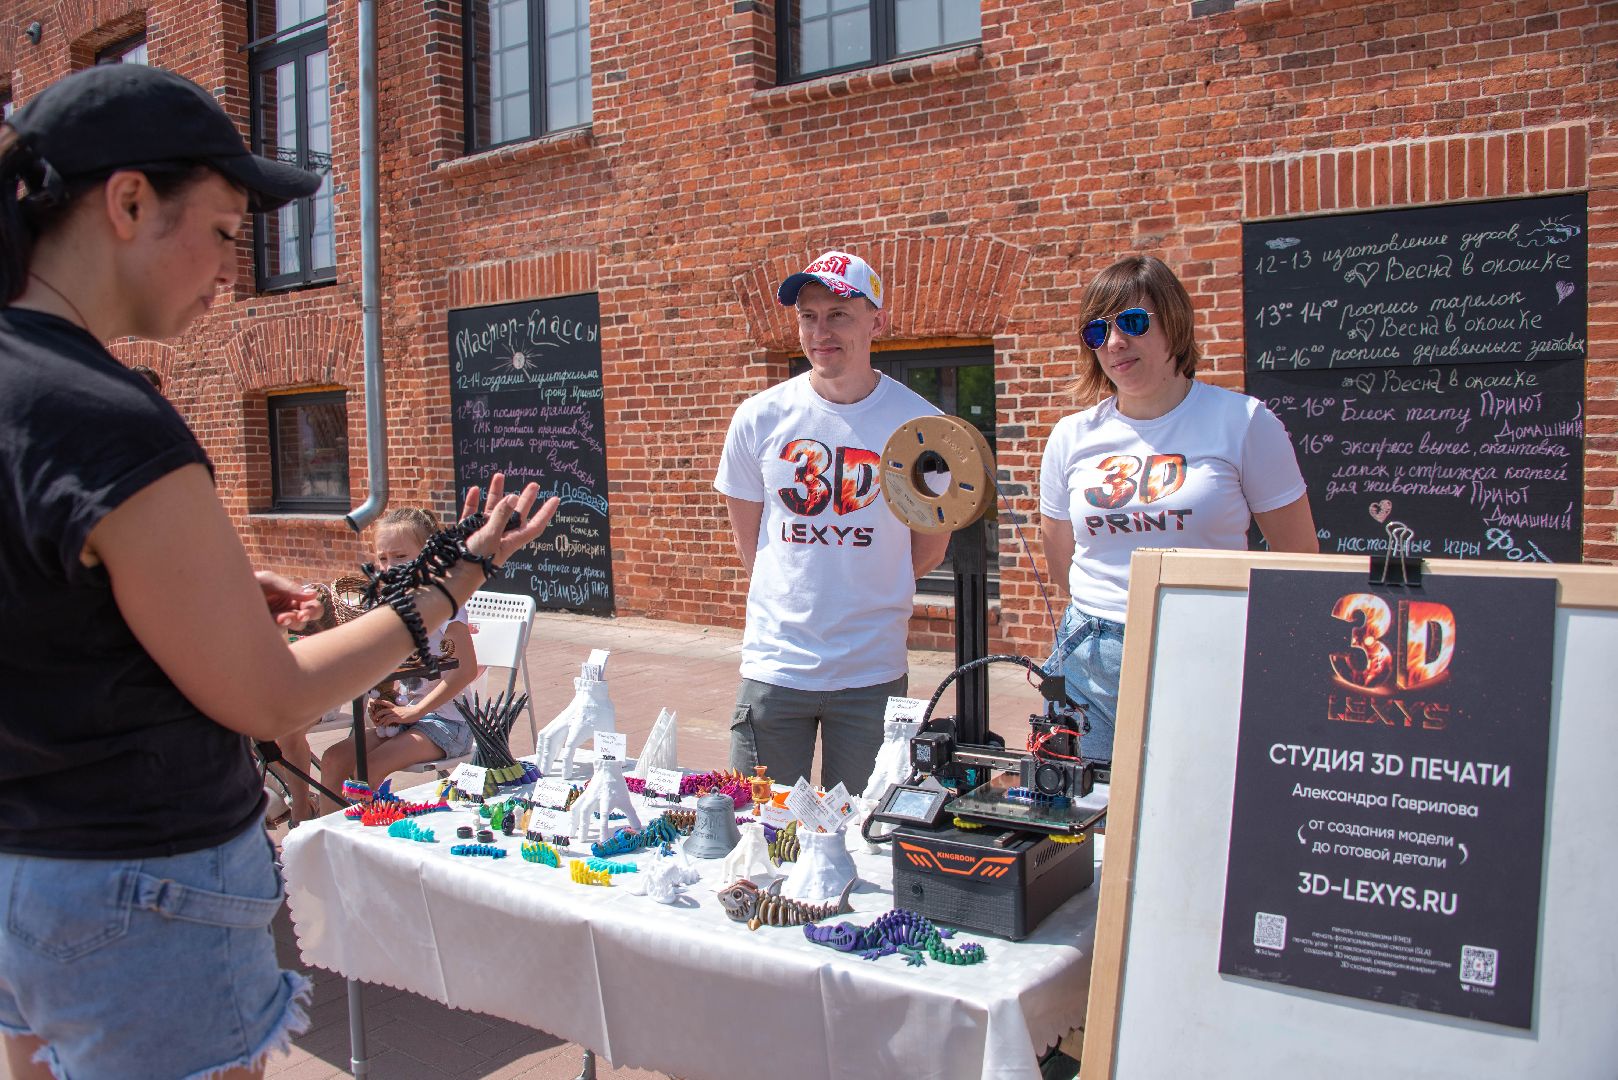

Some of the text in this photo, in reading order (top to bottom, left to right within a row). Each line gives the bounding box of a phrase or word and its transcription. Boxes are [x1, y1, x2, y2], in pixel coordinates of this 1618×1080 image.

[1322, 231, 1448, 272] изготовление
[1460, 223, 1520, 250] духов
[1385, 250, 1573, 282] Весна в окошке
[1340, 301, 1419, 330] роспись
[1430, 291, 1525, 318] тарелок
[1380, 309, 1543, 338] Весна в окошке
[1329, 346, 1400, 369] роспись
[1412, 336, 1522, 366] деревянных
[1381, 368, 1539, 393] Весна в окошке
[1341, 398, 1396, 422] Блеск
[1406, 406, 1472, 434] тату
[1341, 437, 1414, 461] экспресс
[777, 438, 881, 516] 3D
[1084, 453, 1187, 510] 3D
[781, 521, 874, 547] LEXYS
[1085, 509, 1192, 536] PRINT
[1444, 537, 1481, 559] игры
[1329, 592, 1457, 695] 3D
[1327, 695, 1451, 731] LEXYS
[1269, 743, 1512, 788] СТУДИЯ 3D ПЕЧАТИ
[1292, 783, 1479, 817] Александра Гаврилова
[1308, 819, 1454, 848] от создания модели
[937, 851, 976, 863] KINGROON
[1311, 841, 1447, 869] до готовой детали
[1297, 871, 1458, 916] 3D-LEXYS.RU
